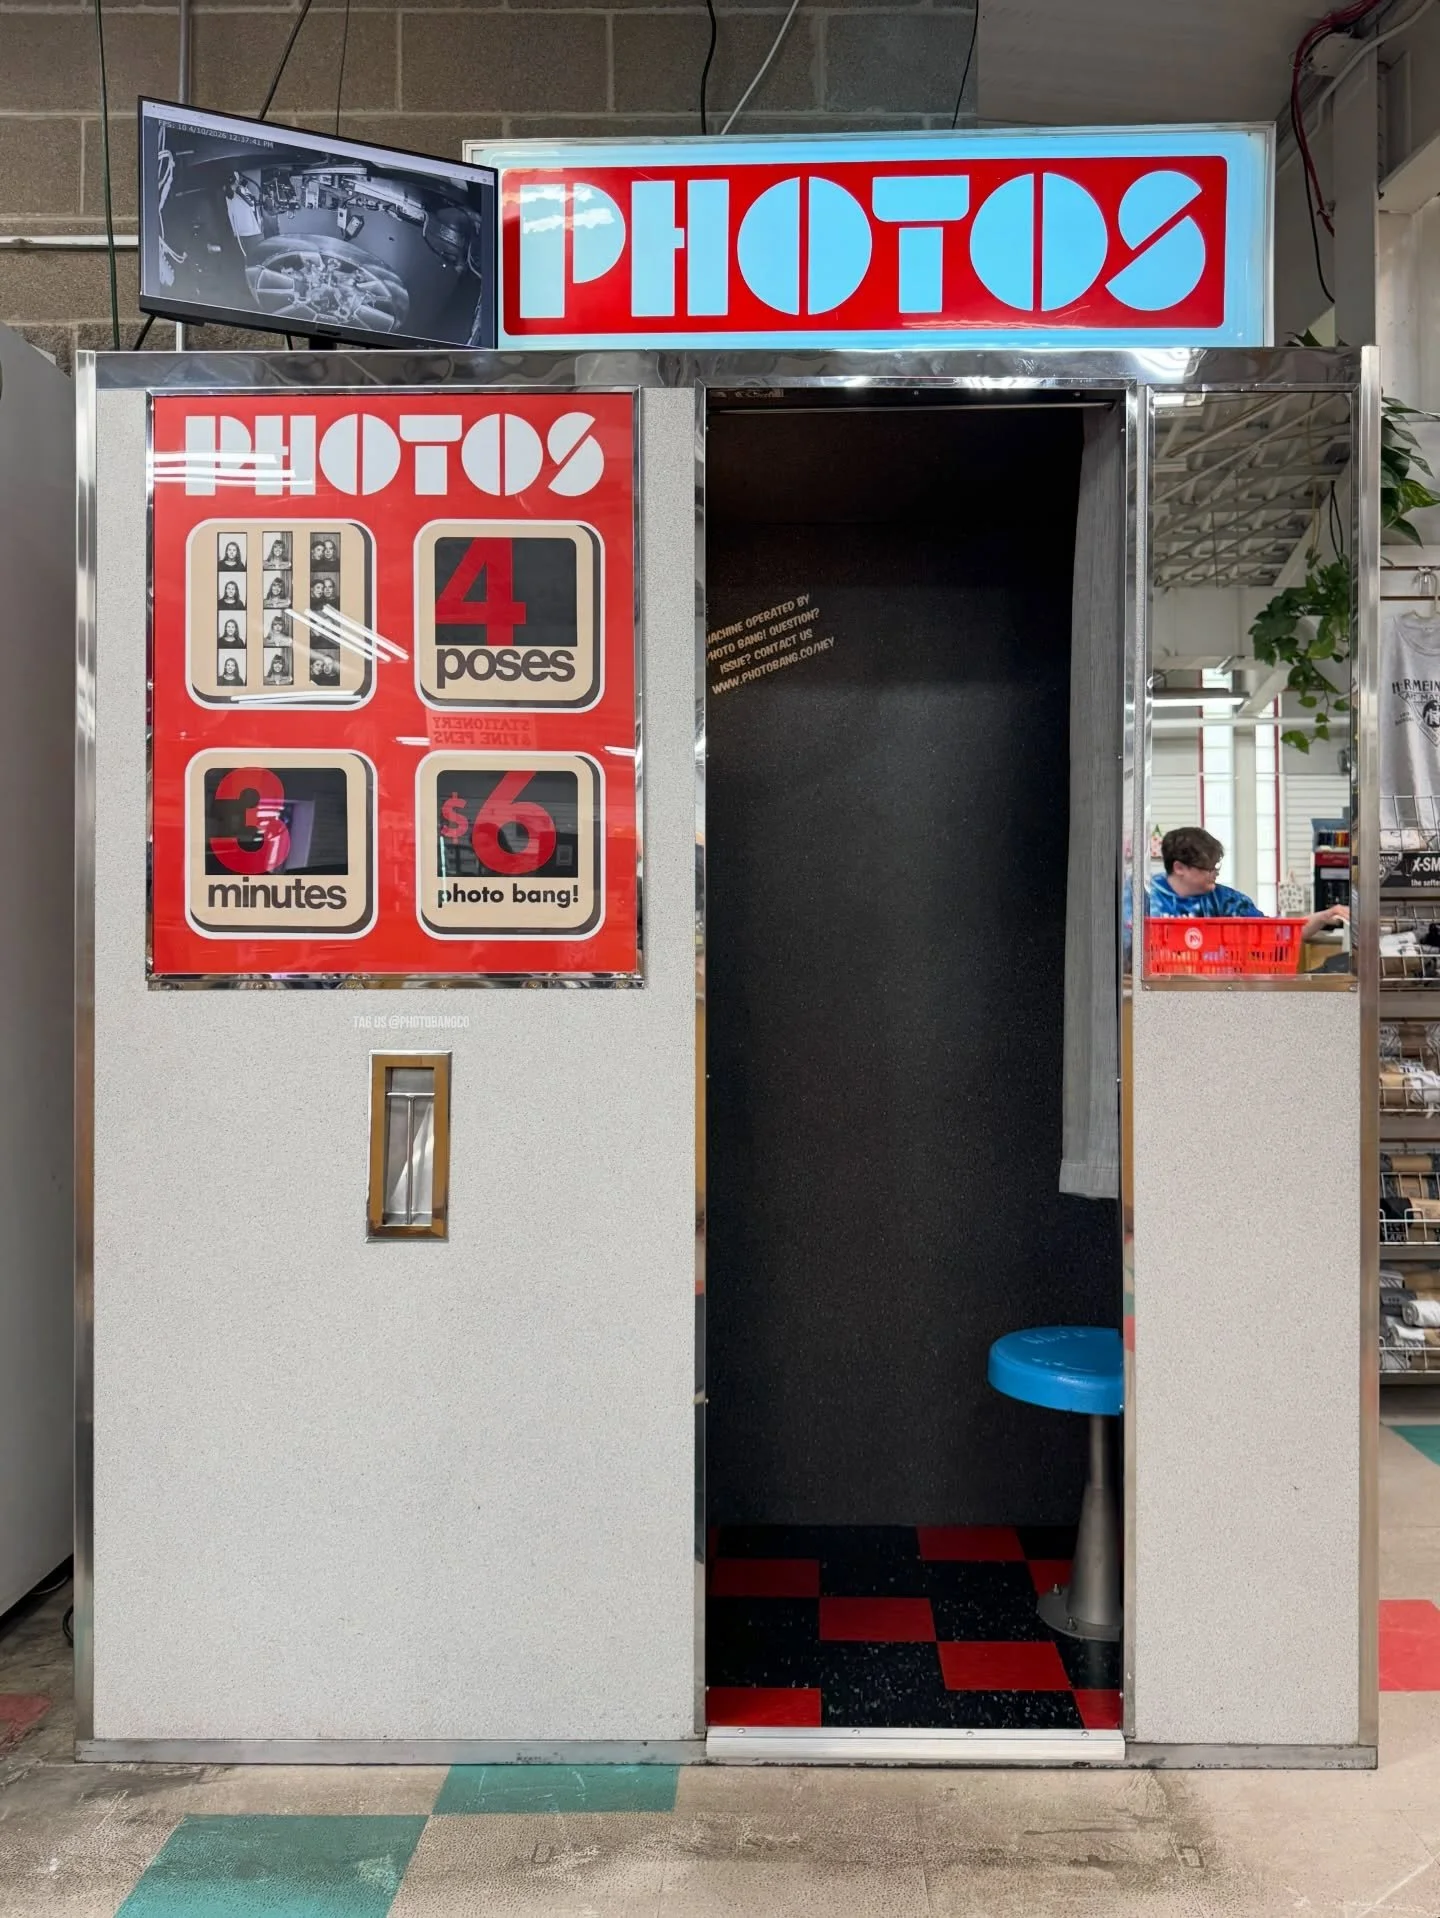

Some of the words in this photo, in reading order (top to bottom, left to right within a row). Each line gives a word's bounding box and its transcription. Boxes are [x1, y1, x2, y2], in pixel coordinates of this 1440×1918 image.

[263, 140, 274, 149] PM
[519, 170, 1206, 319] PHOTOS
[185, 411, 605, 497] PHOTOS
[435, 536, 527, 647] 4
[745, 600, 795, 629] OPERATED
[796, 593, 811, 608] BY
[737, 629, 767, 650] BANG!
[769, 607, 821, 636] QUESTION?
[436, 647, 576, 690] poses
[711, 636, 835, 695] WWW.PHOTOBANG.CO/HEY
[719, 653, 751, 675] ISSUE?
[754, 635, 797, 660] CONTACT
[799, 628, 813, 642] US
[209, 766, 291, 875] 3
[440, 770, 557, 875] $6
[207, 876, 348, 910] minutes
[437, 882, 505, 909] photo
[512, 882, 579, 909] bang!
[352, 1015, 372, 1029] TAG
[374, 1015, 386, 1029] US
[389, 1015, 470, 1029] @PHOTOBANGCO
